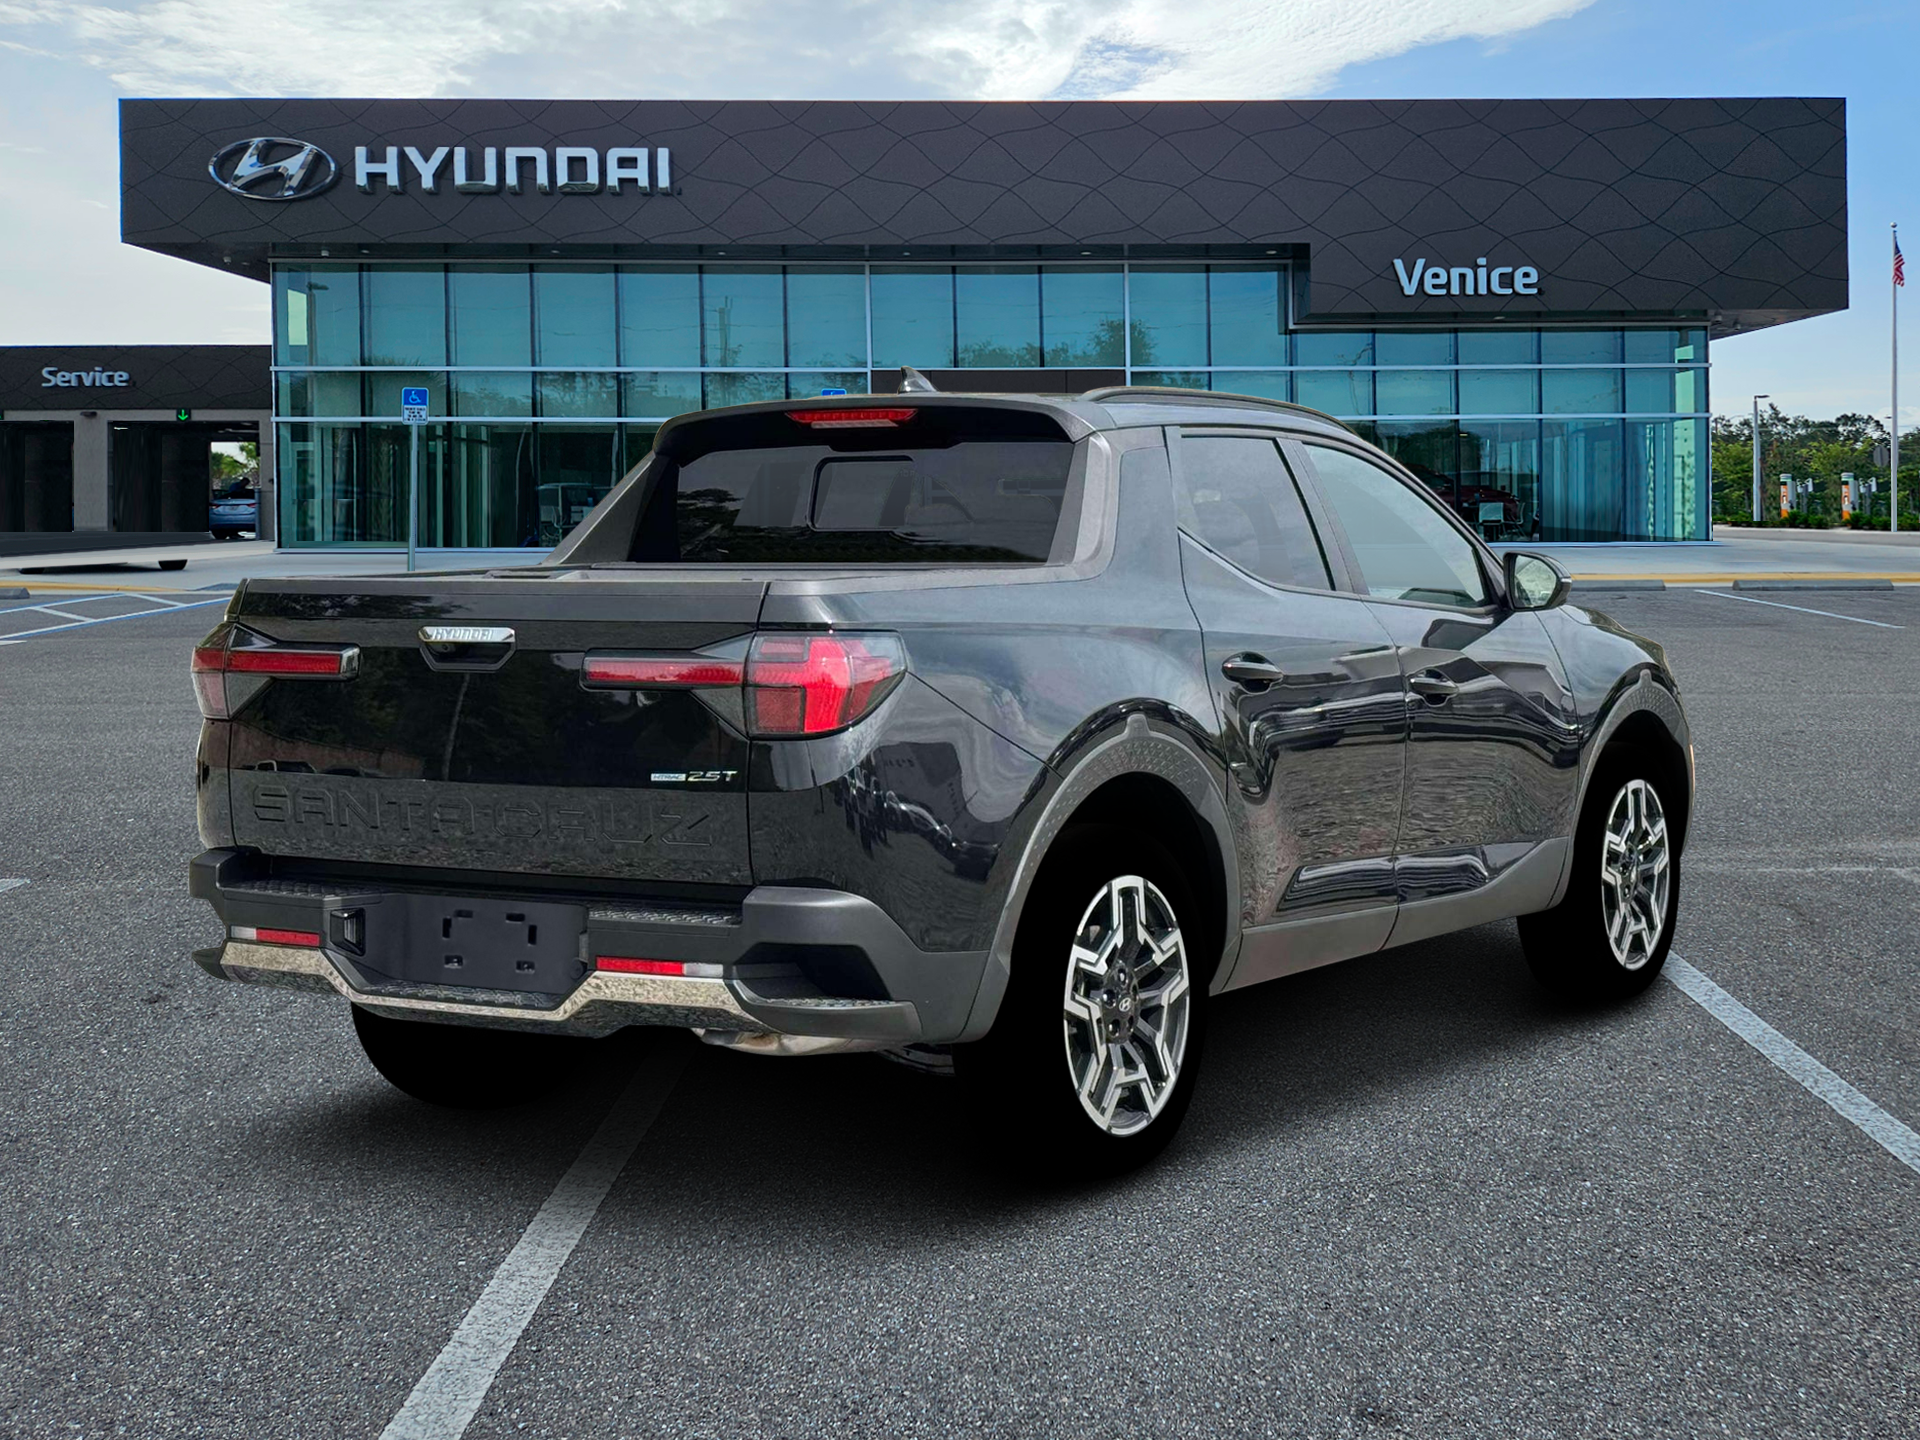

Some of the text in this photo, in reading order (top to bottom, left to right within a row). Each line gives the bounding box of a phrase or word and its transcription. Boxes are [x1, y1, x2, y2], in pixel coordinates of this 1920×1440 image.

[354, 146, 674, 194] HYUNDAI
[1393, 257, 1539, 296] Venice
[41, 366, 130, 388] Service
[432, 628, 494, 641] HYUNDAI
[252, 784, 714, 847] SANTA CRUZ
